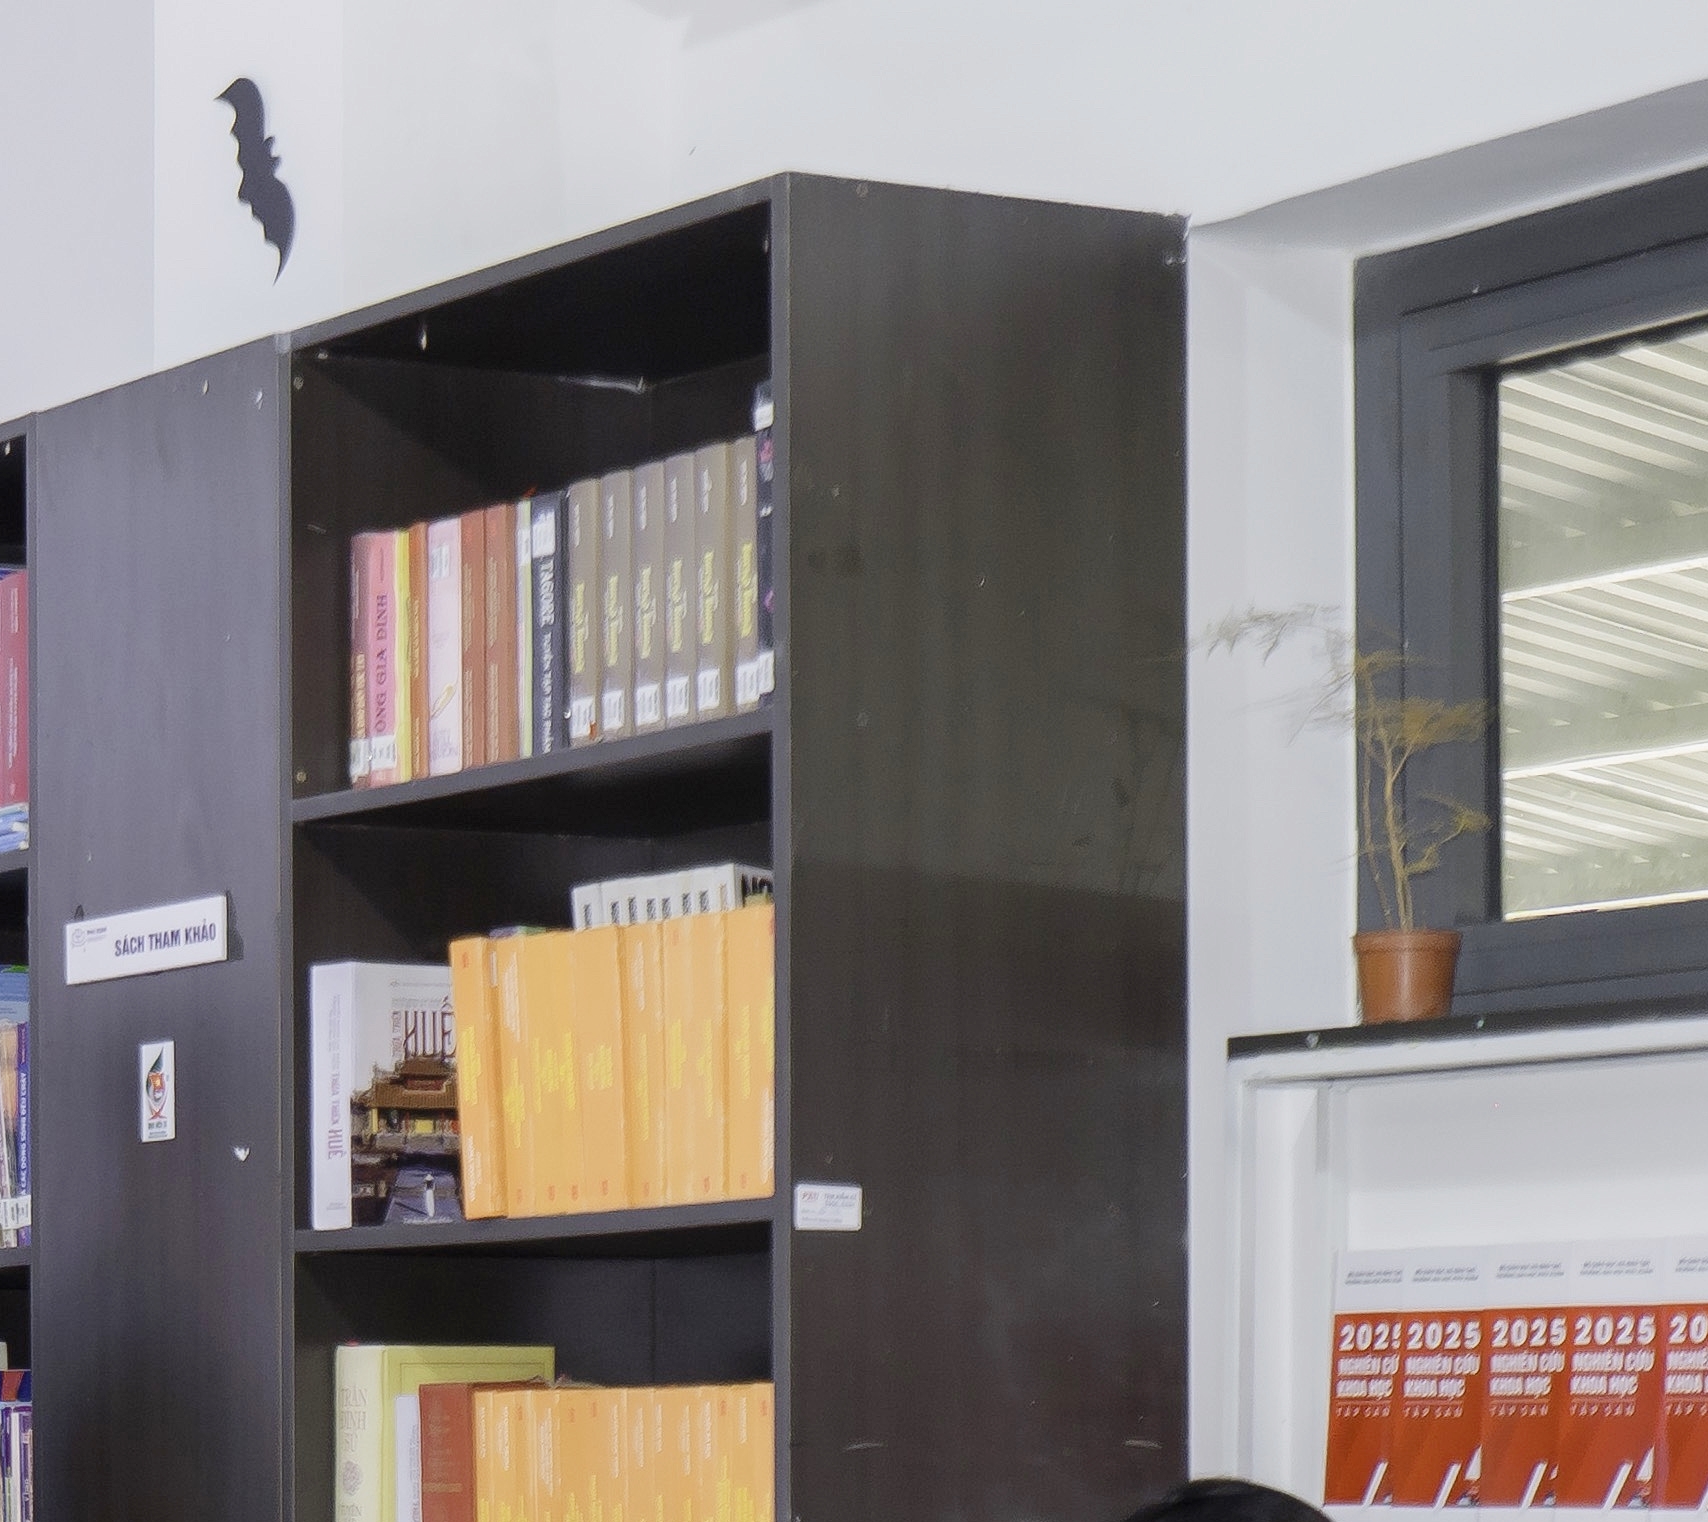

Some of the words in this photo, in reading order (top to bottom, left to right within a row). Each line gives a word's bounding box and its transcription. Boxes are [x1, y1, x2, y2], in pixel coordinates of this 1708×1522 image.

[114, 933, 145, 958] SÁCH
[148, 928, 182, 950] THAM
[185, 917, 217, 943] KHẢO
[1406, 1319, 1482, 1350] 2025
[1491, 1316, 1567, 1347] 2025
[1573, 1313, 1656, 1346] 2025
[1668, 1313, 1708, 1345] 20
